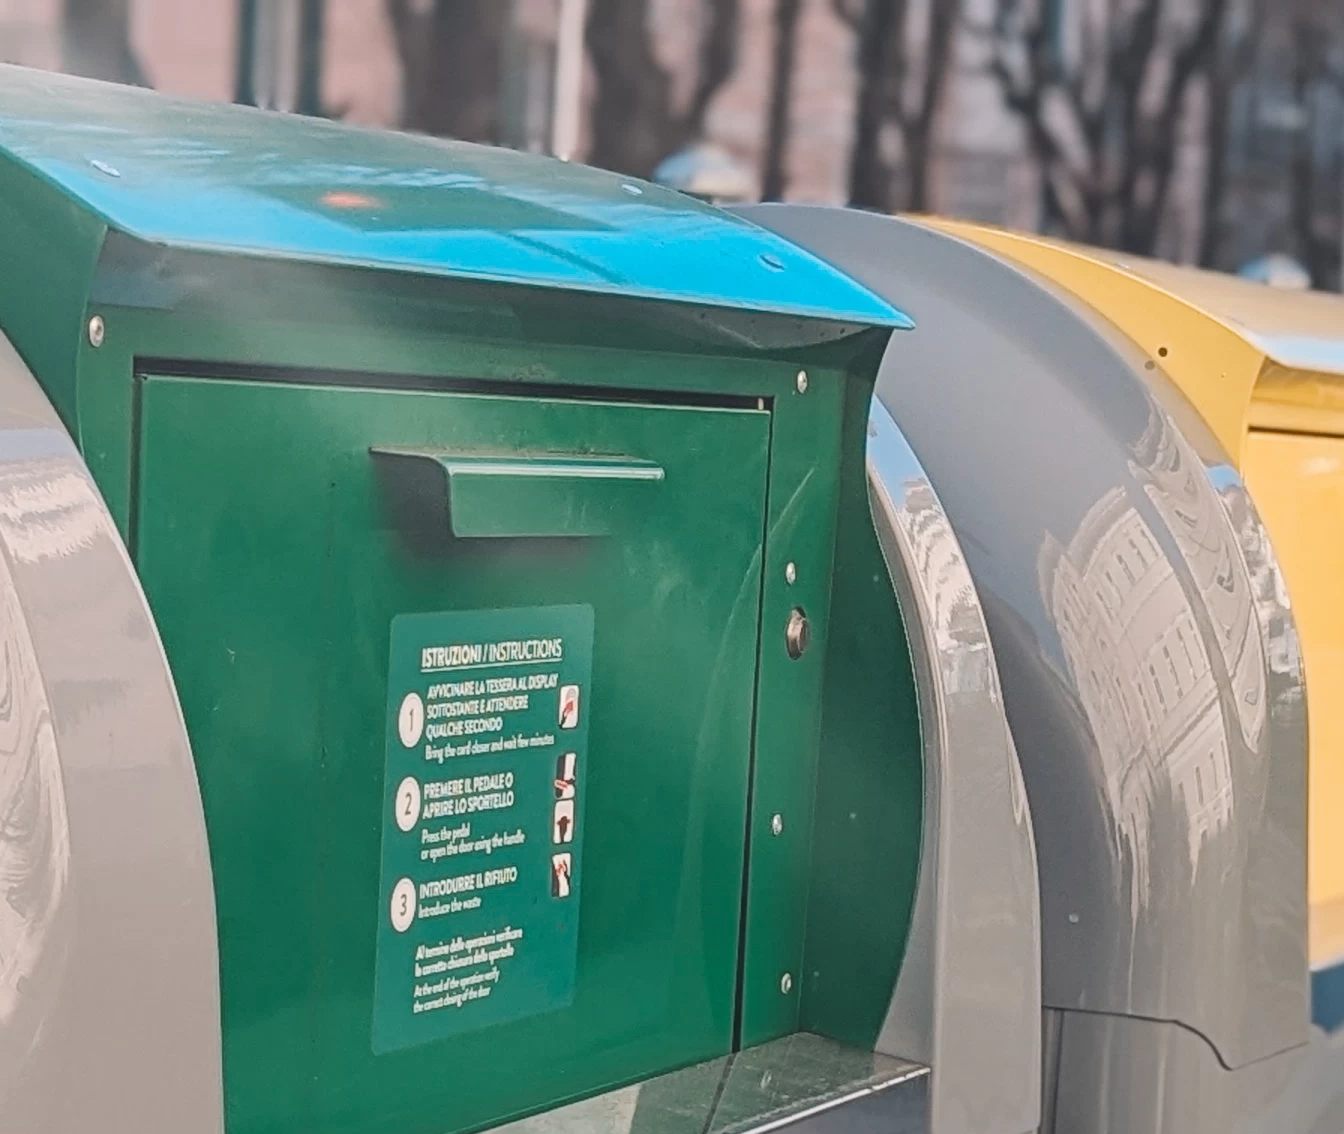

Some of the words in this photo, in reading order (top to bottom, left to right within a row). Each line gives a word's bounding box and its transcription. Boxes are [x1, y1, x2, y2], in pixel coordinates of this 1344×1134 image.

[422, 645, 482, 667] ISTRUZIONI
[489, 639, 561, 661] INSTRUCTIONS
[475, 681, 485, 695] LA
[486, 678, 517, 693] TESSERA
[518, 677, 528, 690] AL
[527, 674, 558, 689] DISPLAY
[427, 700, 479, 719] SOTTOSTANTE
[480, 699, 485, 713] E
[486, 695, 528, 712] ATTENDERE
[426, 721, 464, 741] QUALCHE
[465, 717, 502, 734] SECONDO
[426, 745, 443, 763] Bring
[424, 779, 464, 799] PREMERE
[465, 779, 472, 793] IL
[473, 774, 504, 792] PEDALE
[505, 773, 513, 788] O
[423, 799, 453, 819] APRIRE
[455, 798, 467, 814] LO
[466, 791, 513, 812] SPORTELLO
[422, 829, 440, 843] Press
[439, 827, 452, 840] the
[420, 874, 475, 898] INTRODURRE
[476, 874, 485, 888] IL
[484, 867, 517, 886] RIFIUTO
